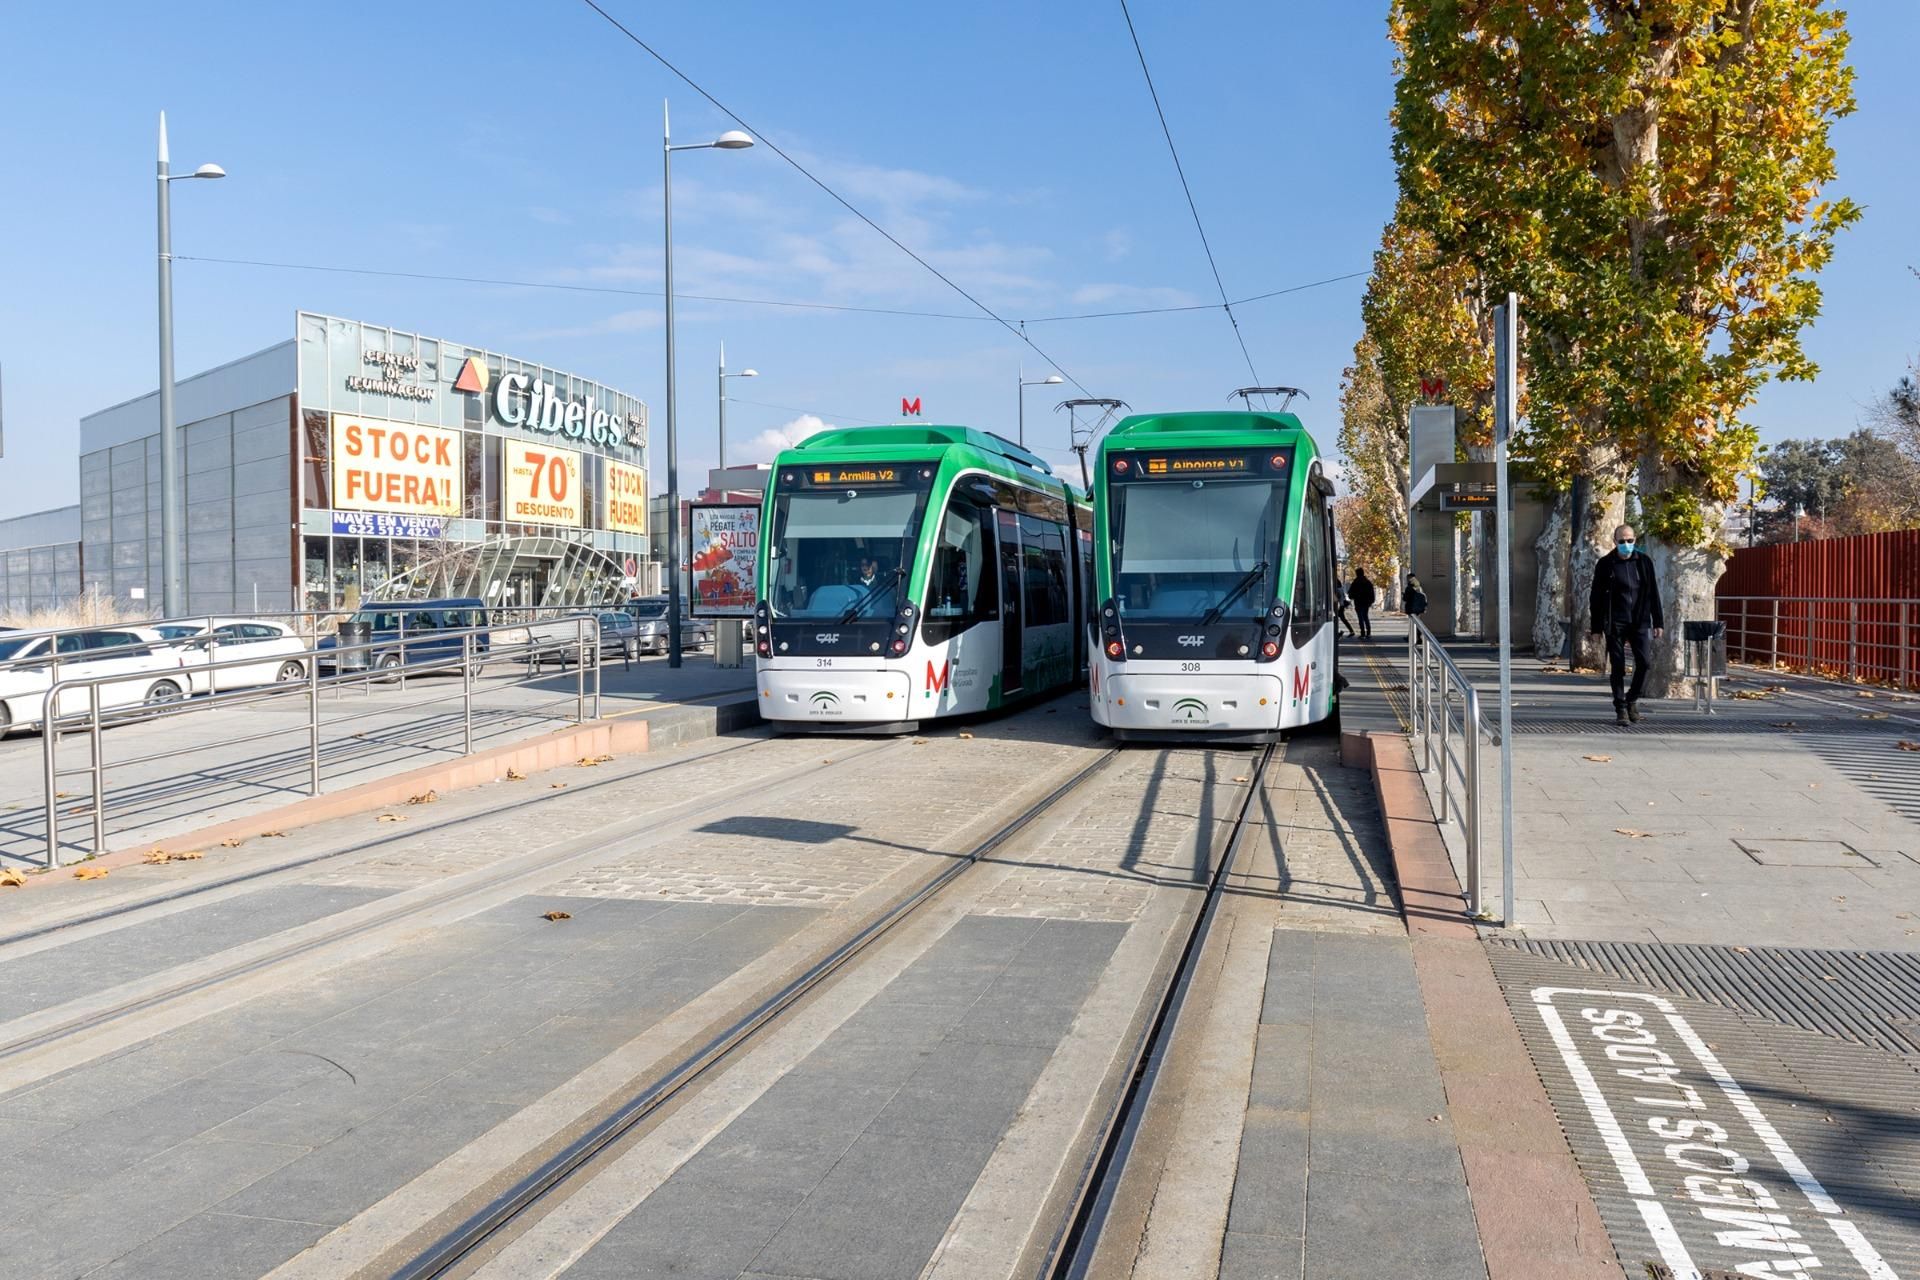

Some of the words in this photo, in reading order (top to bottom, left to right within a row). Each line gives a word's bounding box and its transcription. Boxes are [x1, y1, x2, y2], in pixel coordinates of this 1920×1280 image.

[496, 373, 622, 447] Cibeles
[345, 425, 452, 466] STOCK
[513, 467, 533, 477] HASTA
[839, 471, 877, 481] Armilla
[879, 470, 894, 480] V2
[346, 468, 451, 507] FUERA!!
[610, 466, 642, 497] STOCK
[516, 501, 575, 519] DESCUENTO
[334, 512, 374, 526] NAVE
[377, 515, 397, 527] EN
[400, 517, 440, 529] VENTA
[710, 520, 736, 531] PÉGATE
[347, 524, 375, 535] 622
[378, 525, 404, 536] 513
[720, 531, 757, 548] SALTO
[815, 633, 840, 645] CAF
[1177, 635, 1205, 647] CAF
[816, 658, 832, 668] 314
[1181, 662, 1201, 672] 308
[1580, 1007, 1708, 1110] LADOS
